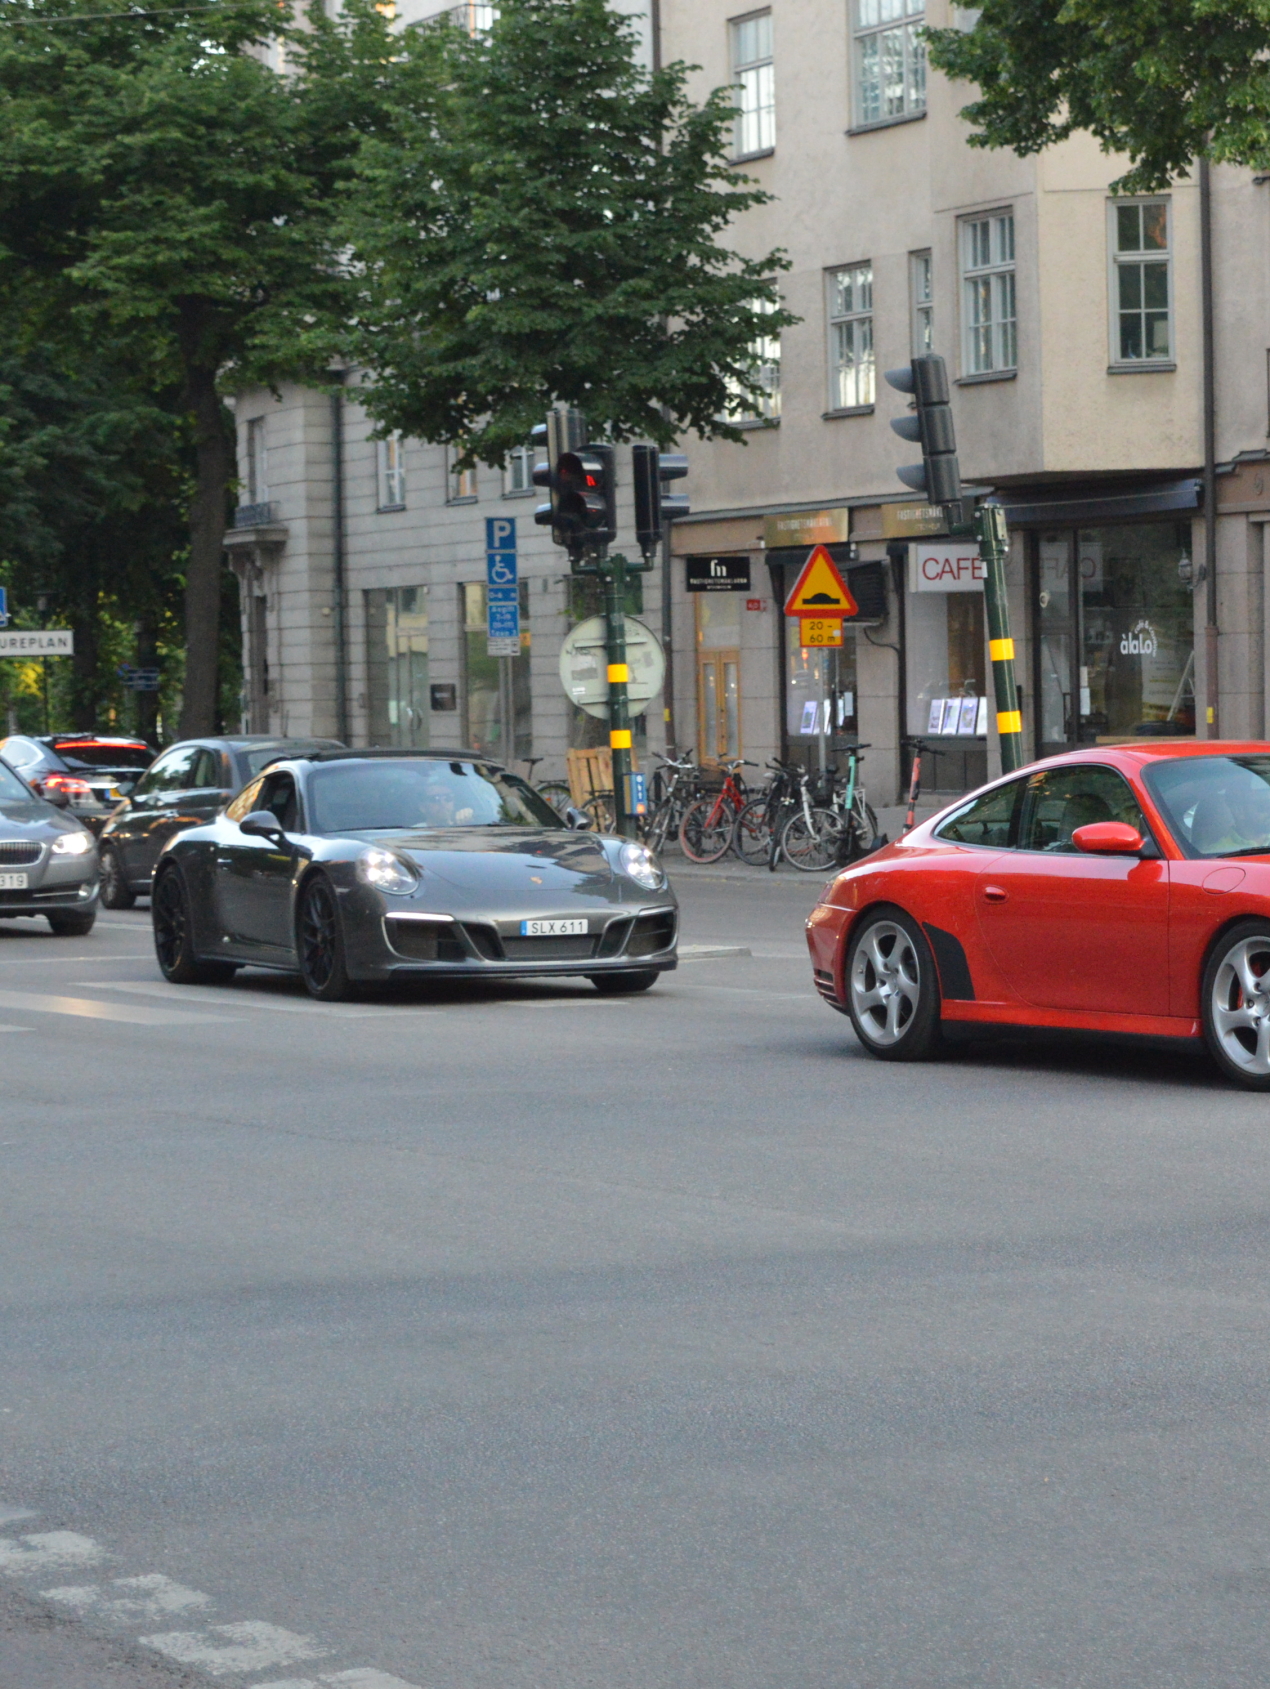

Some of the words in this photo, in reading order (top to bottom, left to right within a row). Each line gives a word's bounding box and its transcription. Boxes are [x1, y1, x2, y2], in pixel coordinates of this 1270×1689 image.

[493, 520, 511, 548] P
[810, 621, 823, 630] 20
[810, 634, 823, 643] 60
[531, 922, 555, 934] SLX
[560, 921, 583, 933] 611
